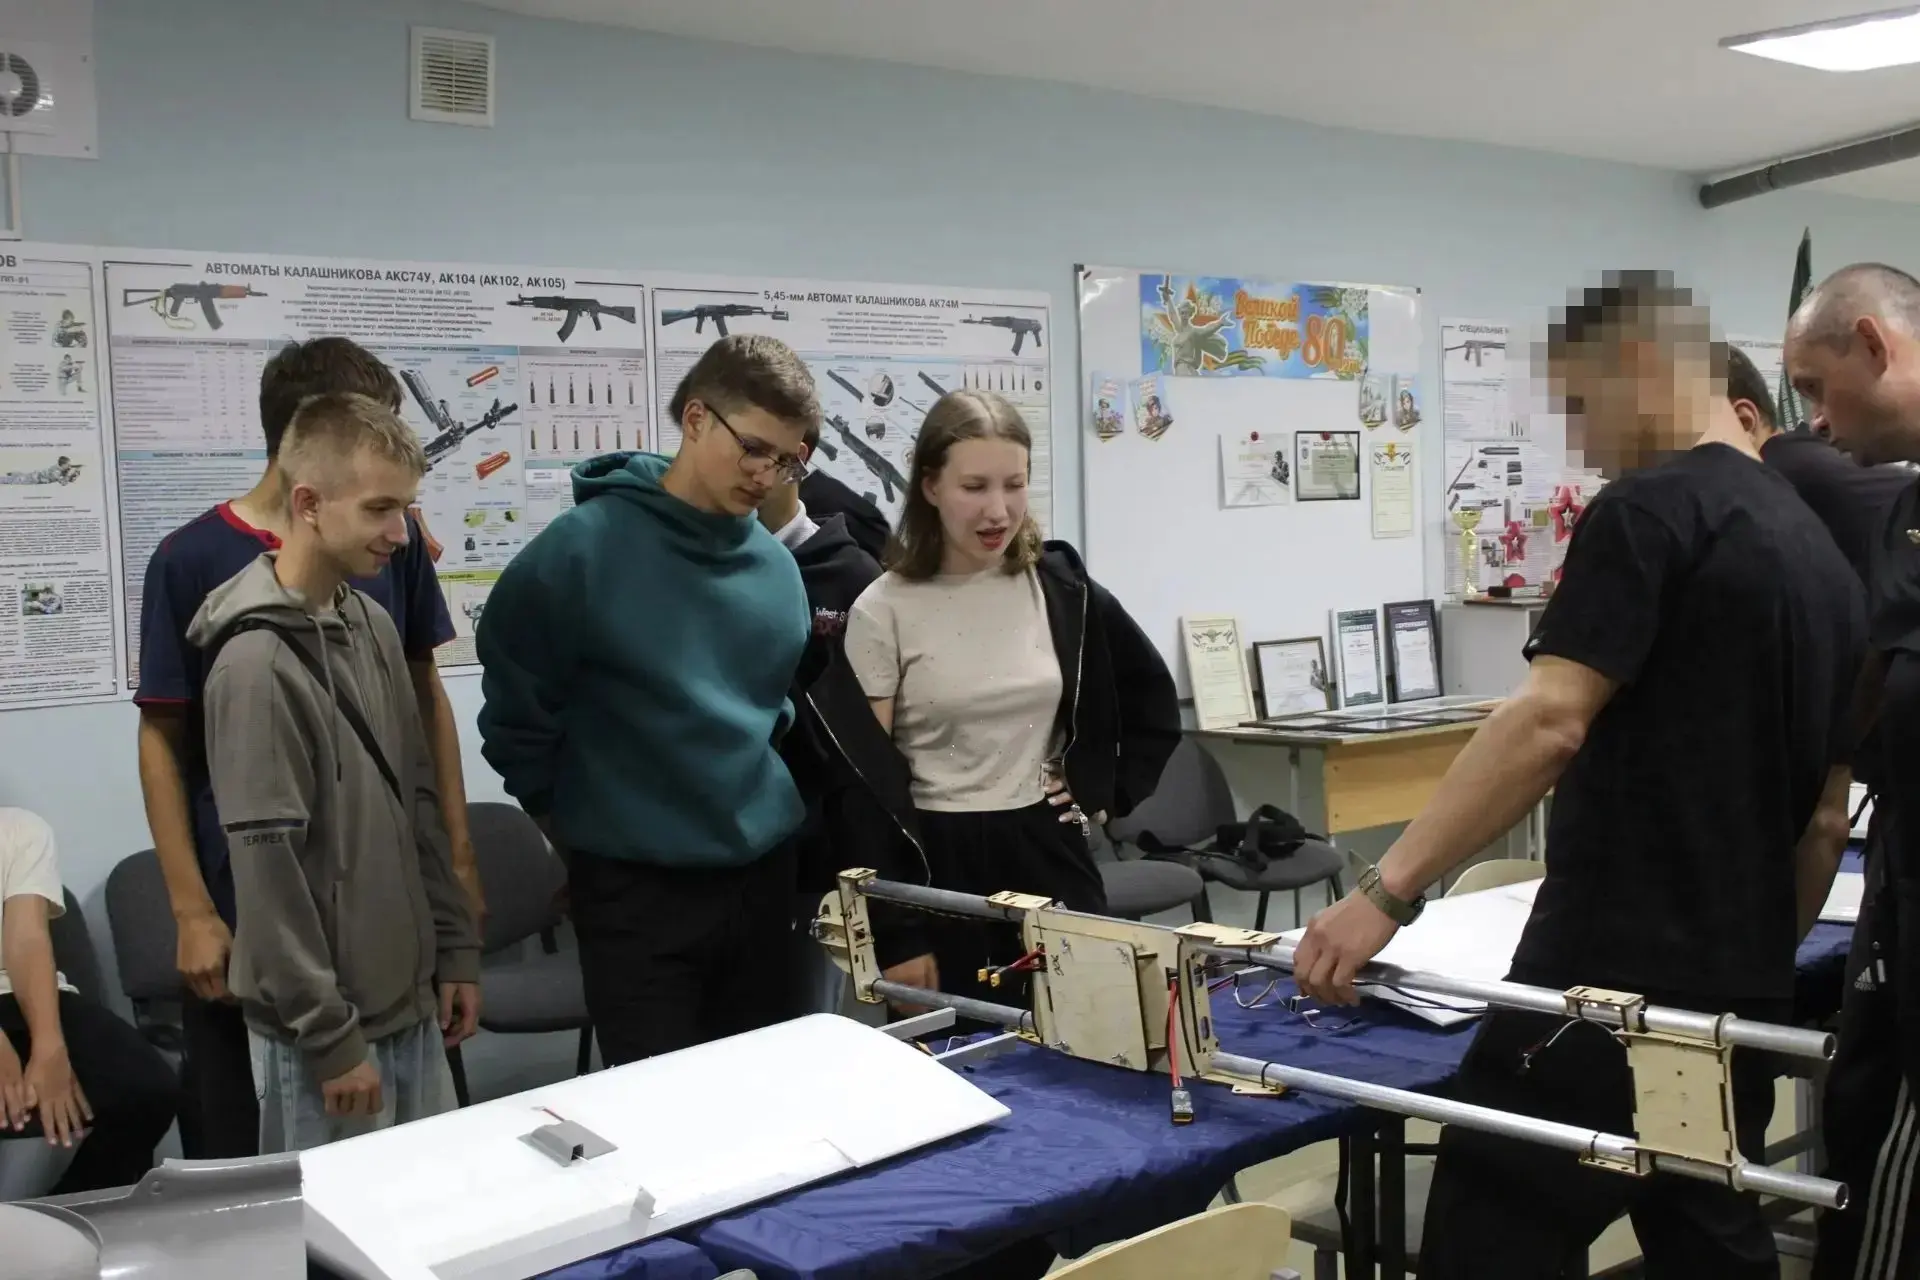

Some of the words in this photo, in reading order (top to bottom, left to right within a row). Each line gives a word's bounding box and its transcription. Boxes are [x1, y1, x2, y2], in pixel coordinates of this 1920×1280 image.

[205, 263, 280, 277] АВТОМАТЫ
[284, 266, 382, 281] КАЛАШНИКОВА
[385, 271, 436, 285] АКС74У,
[439, 273, 476, 285] АК104
[480, 275, 523, 289] (АК102,
[526, 277, 566, 290] АК105)
[763, 290, 805, 302] 5,45-мм
[807, 293, 853, 304] АВТОМАТ
[855, 295, 927, 308] КАЛАШНИКОВА
[929, 298, 959, 308] АК74М
[1302, 315, 1345, 369] 80
